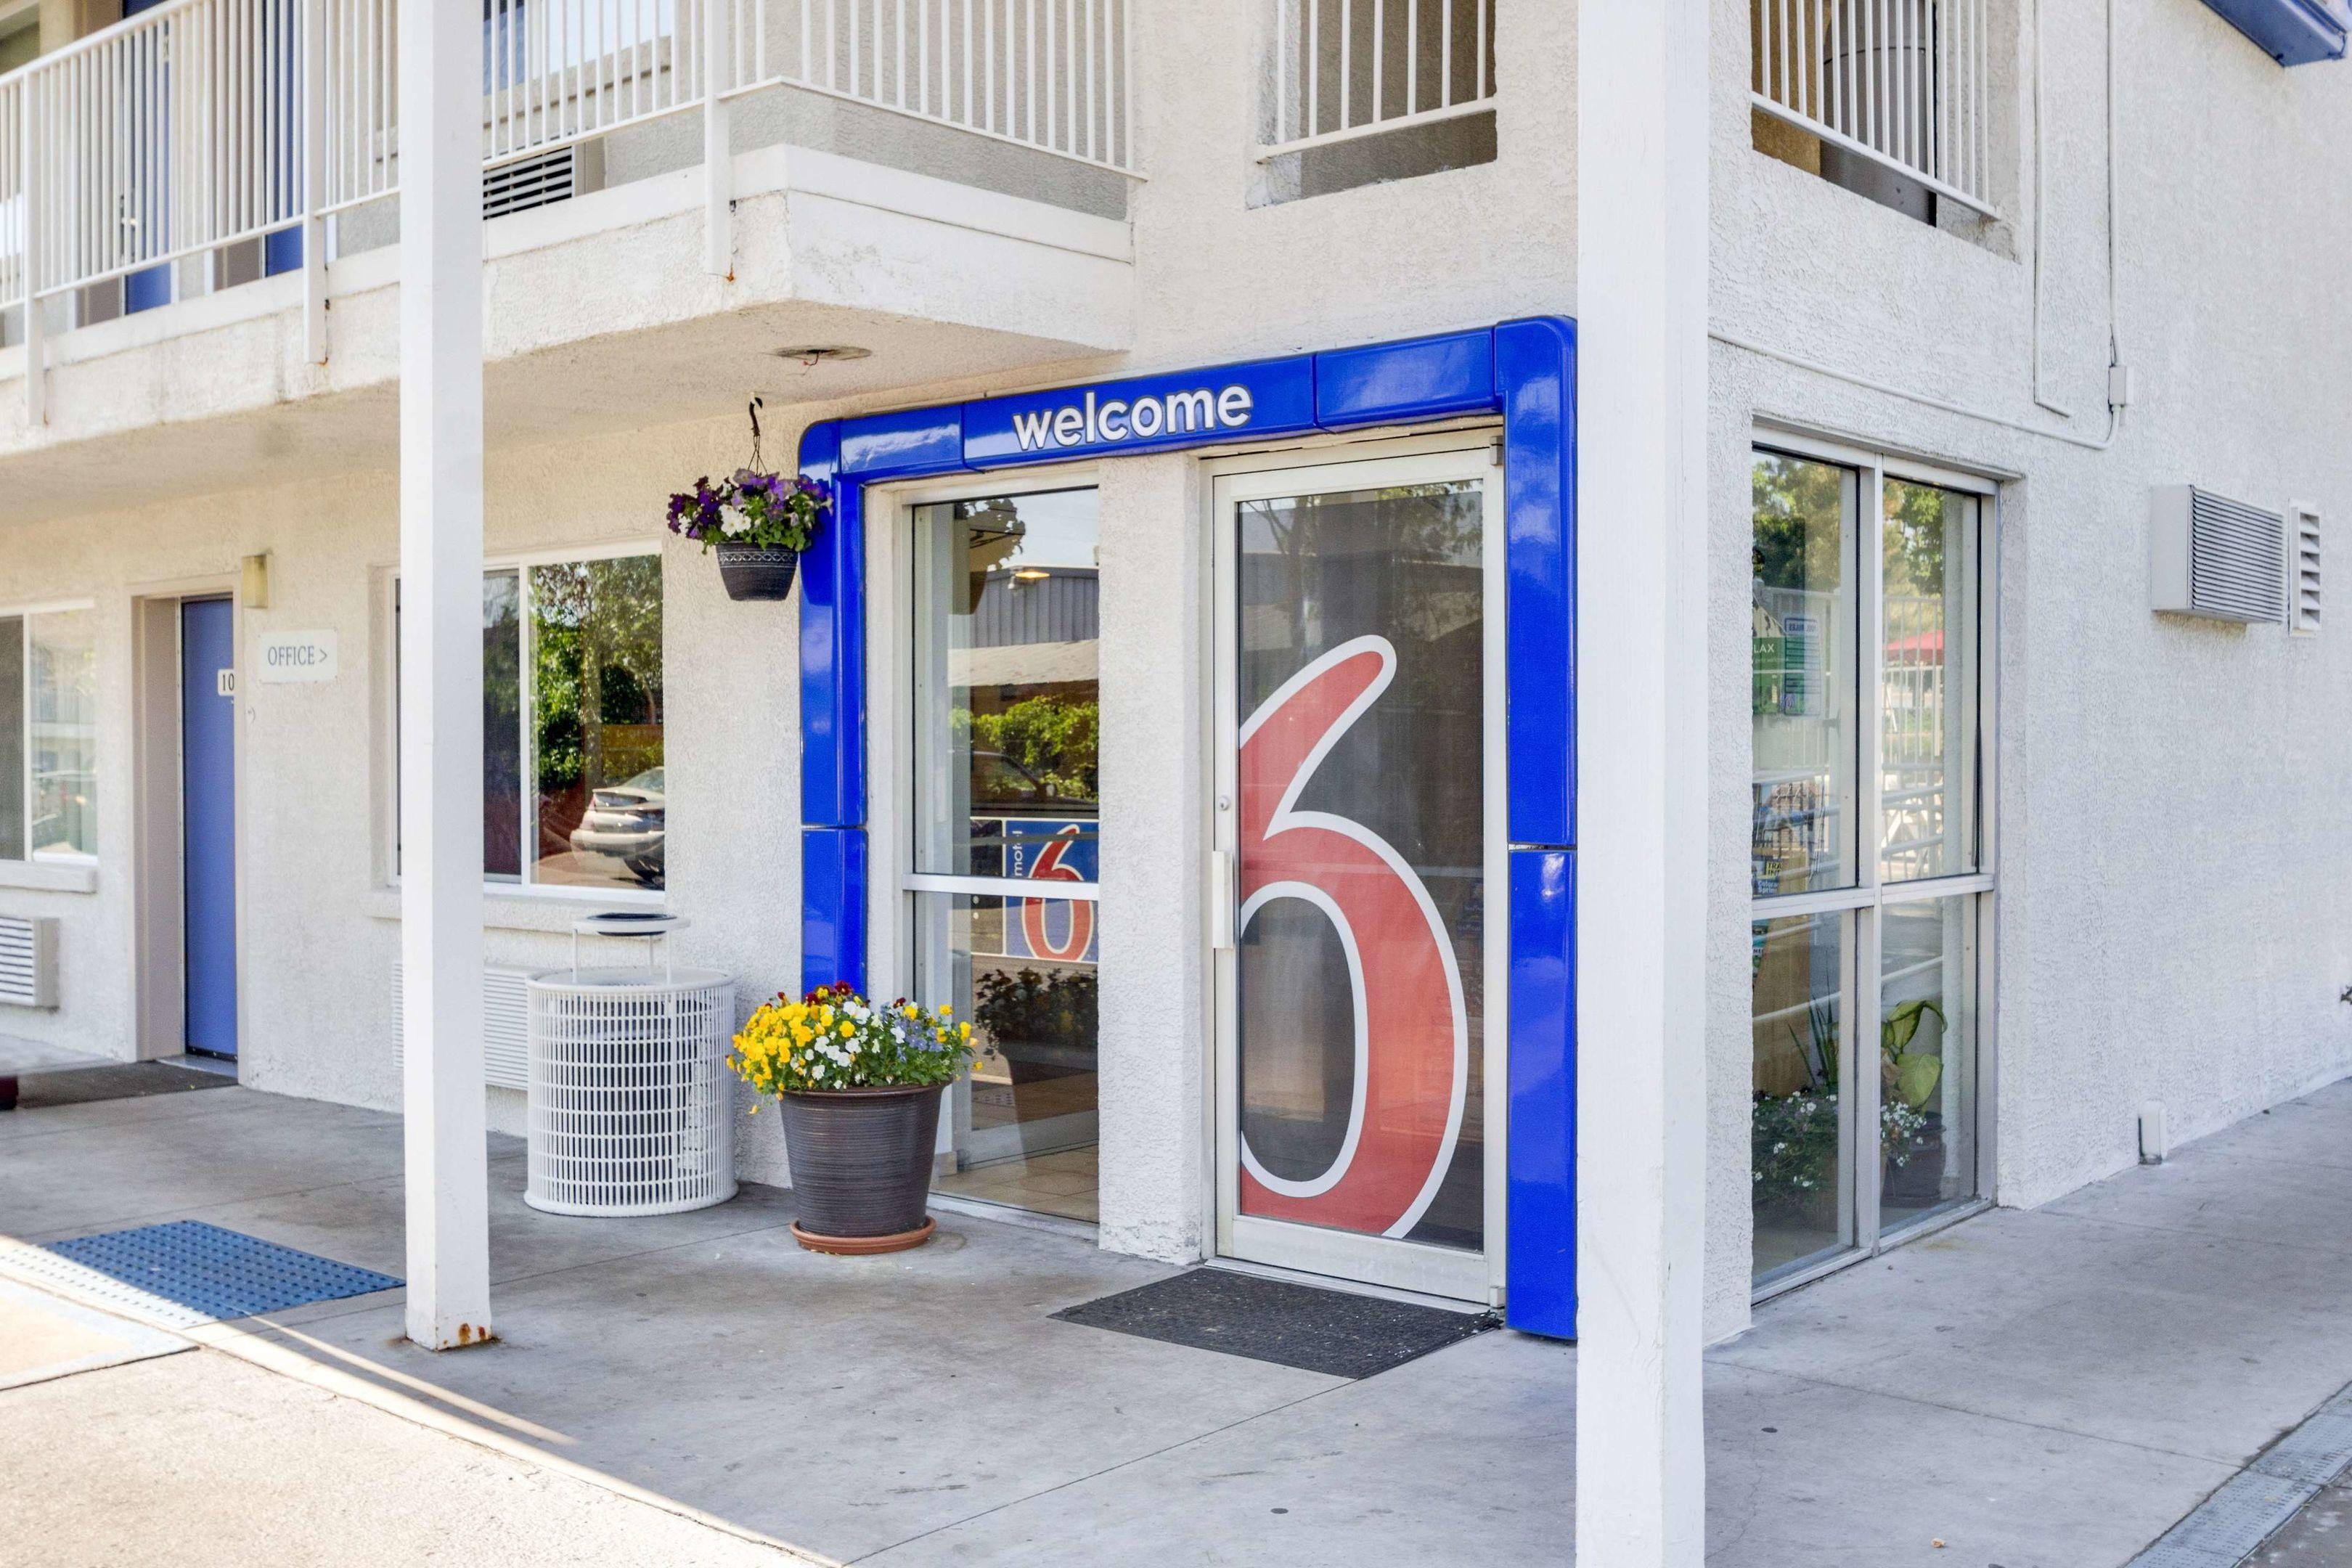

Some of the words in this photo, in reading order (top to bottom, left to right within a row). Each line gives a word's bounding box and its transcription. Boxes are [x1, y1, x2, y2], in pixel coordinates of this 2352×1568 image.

[1013, 385, 1253, 451] welcome
[268, 645, 315, 666] OFFICE
[1012, 830, 1024, 877] motl
[1021, 823, 1095, 962] 6
[1240, 634, 1467, 1239] 6
